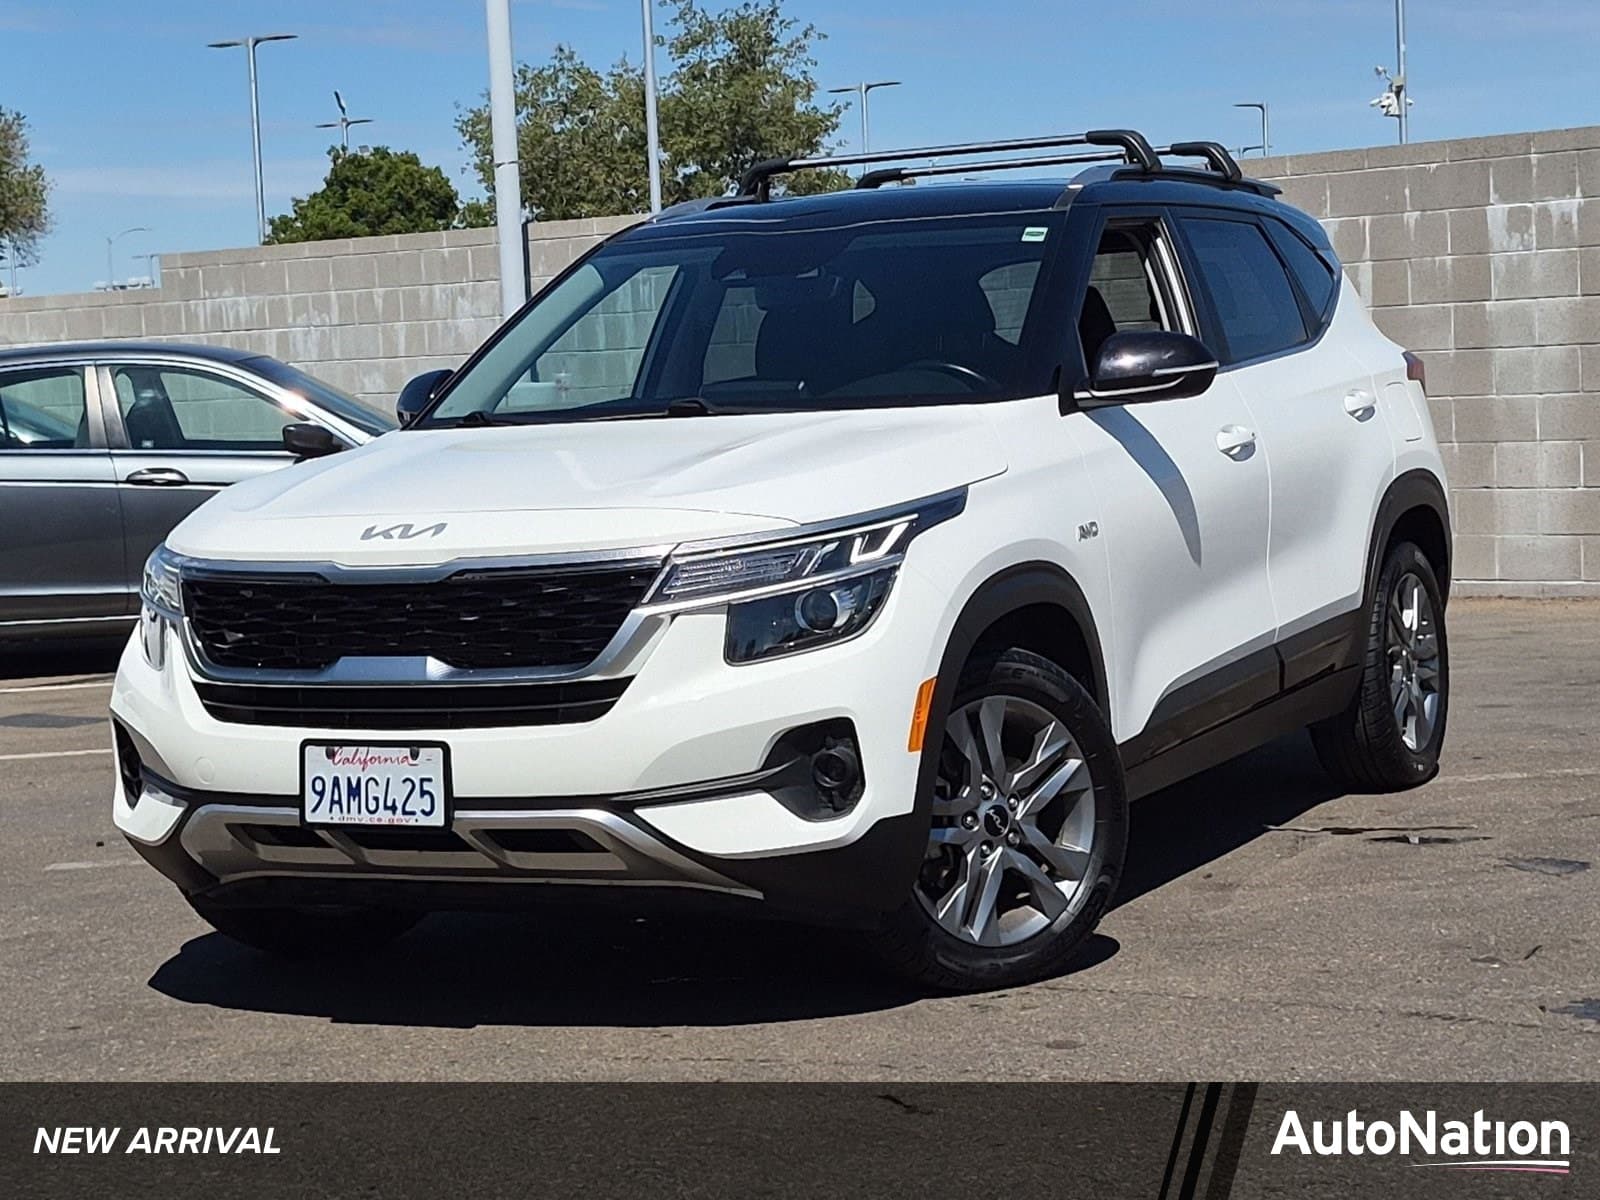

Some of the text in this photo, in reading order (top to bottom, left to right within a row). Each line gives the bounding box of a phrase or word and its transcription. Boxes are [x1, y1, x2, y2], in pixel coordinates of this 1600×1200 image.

[1078, 521, 1099, 542] AWD
[331, 746, 420, 772] California
[310, 775, 436, 817] 9AMG425
